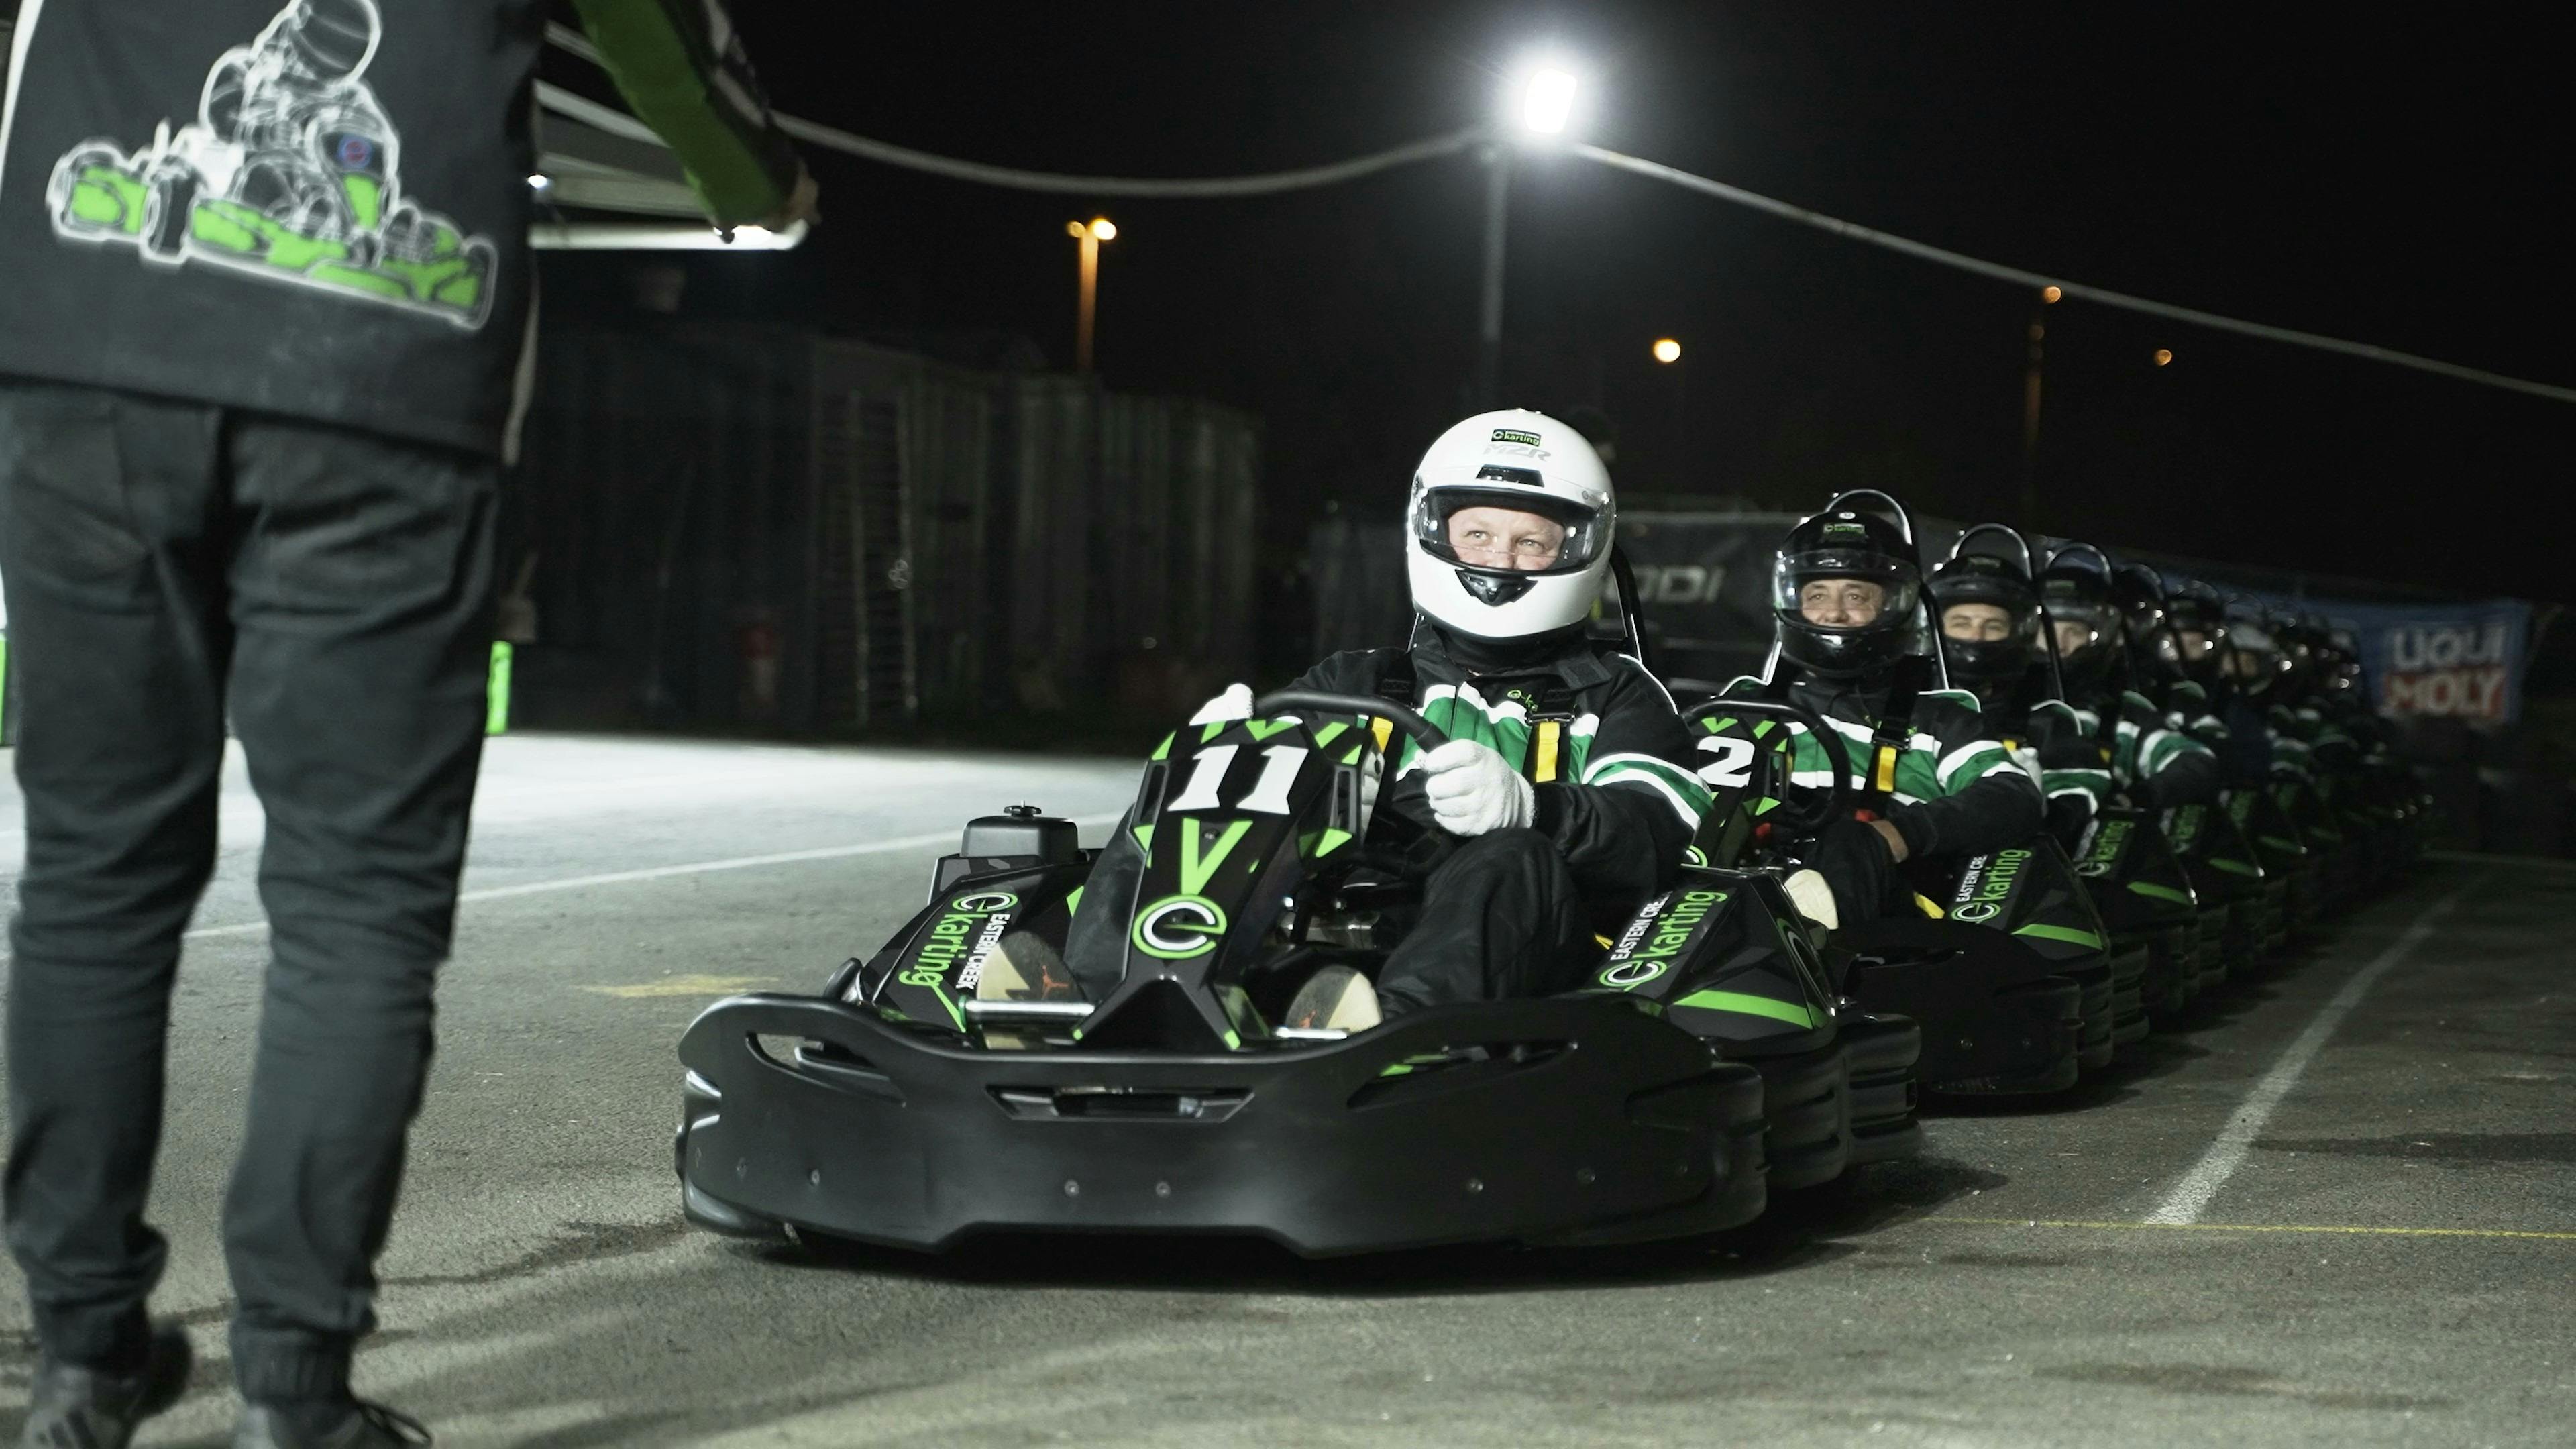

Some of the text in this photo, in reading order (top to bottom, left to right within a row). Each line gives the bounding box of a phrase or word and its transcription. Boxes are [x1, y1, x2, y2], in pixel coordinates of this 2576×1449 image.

[1504, 431, 1540, 445] karting
[1168, 745, 1309, 815] 11
[1697, 736, 1756, 788] 2
[1957, 863, 1982, 902] EASTERN
[1972, 849, 2032, 900] karting
[899, 914, 989, 985] karting
[955, 914, 1010, 990] EASTERN CREEK
[1610, 905, 1654, 960] EASTERN
[1633, 891, 1728, 958] karting
